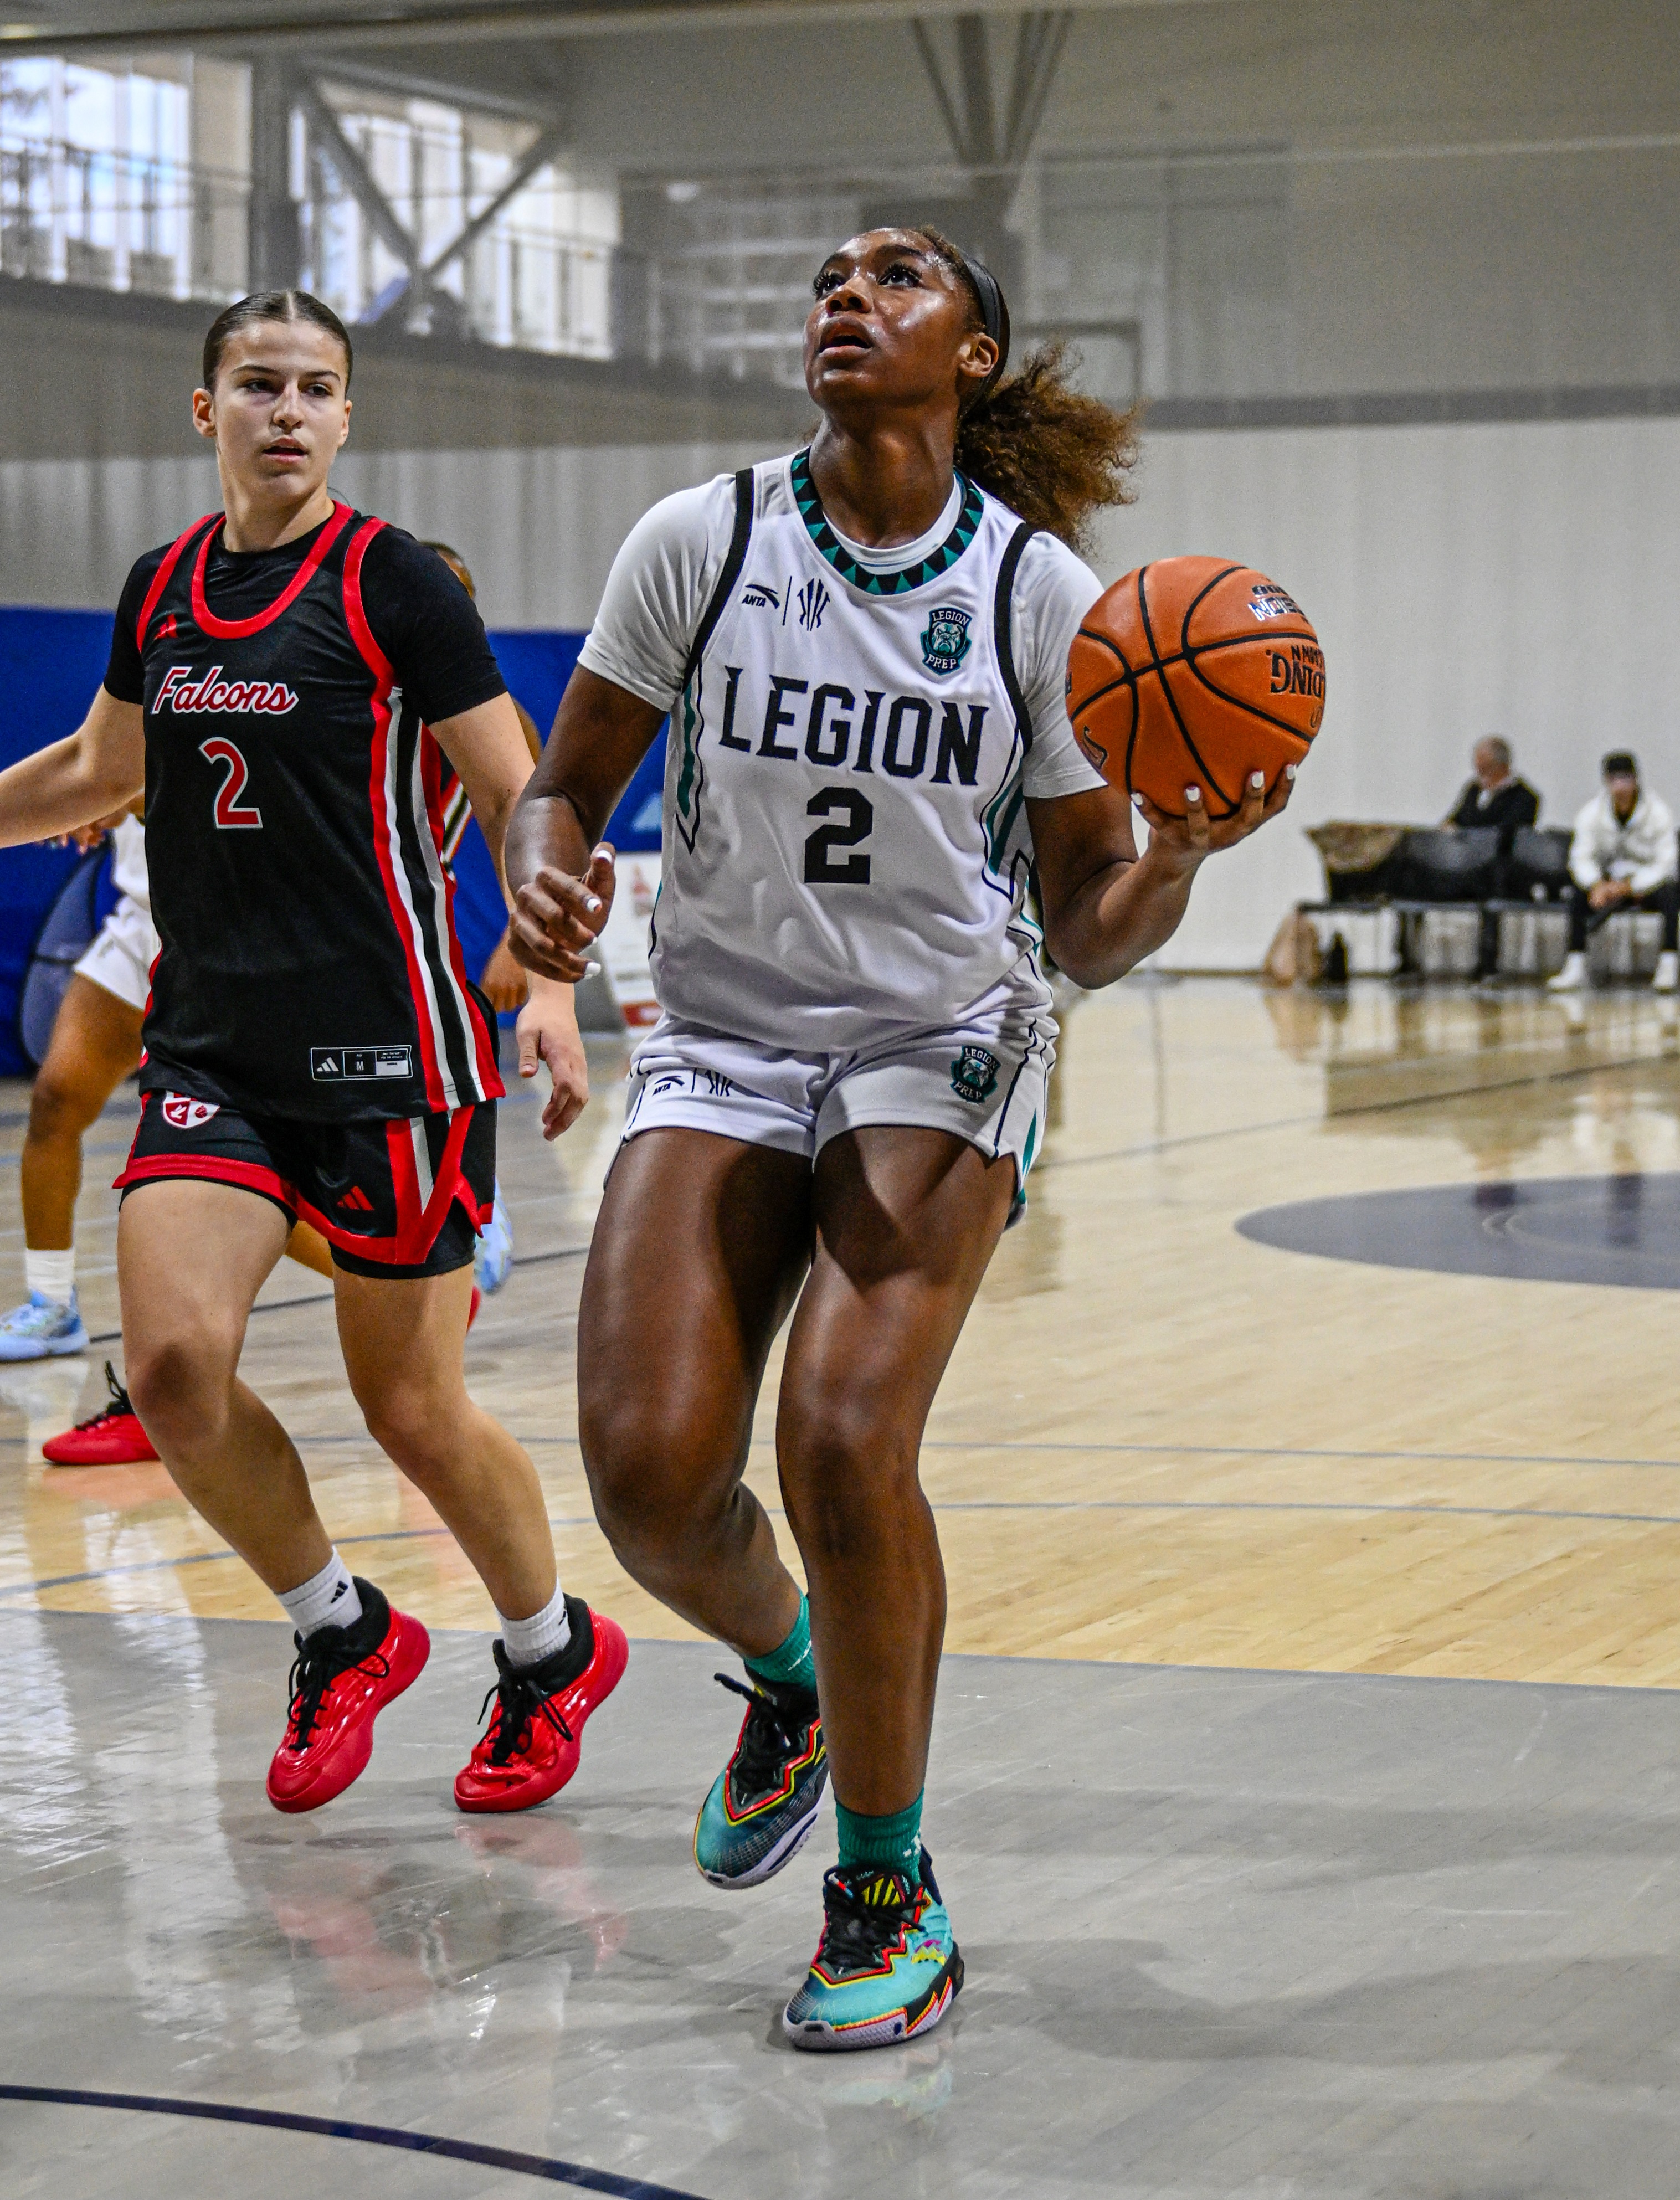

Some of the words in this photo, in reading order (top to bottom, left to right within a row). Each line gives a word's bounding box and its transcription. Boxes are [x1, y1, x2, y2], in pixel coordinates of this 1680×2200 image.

[741, 594, 767, 608] ANTA
[931, 610, 970, 626] LEGION
[924, 654, 957, 669] PREP
[151, 665, 300, 715] Falcons
[718, 664, 989, 787] LEGION
[198, 736, 264, 830] 2
[804, 786, 874, 885] 2
[356, 1061, 364, 1071] M
[964, 1047, 998, 1069] LEGION
[953, 1081, 982, 1100] PREP
